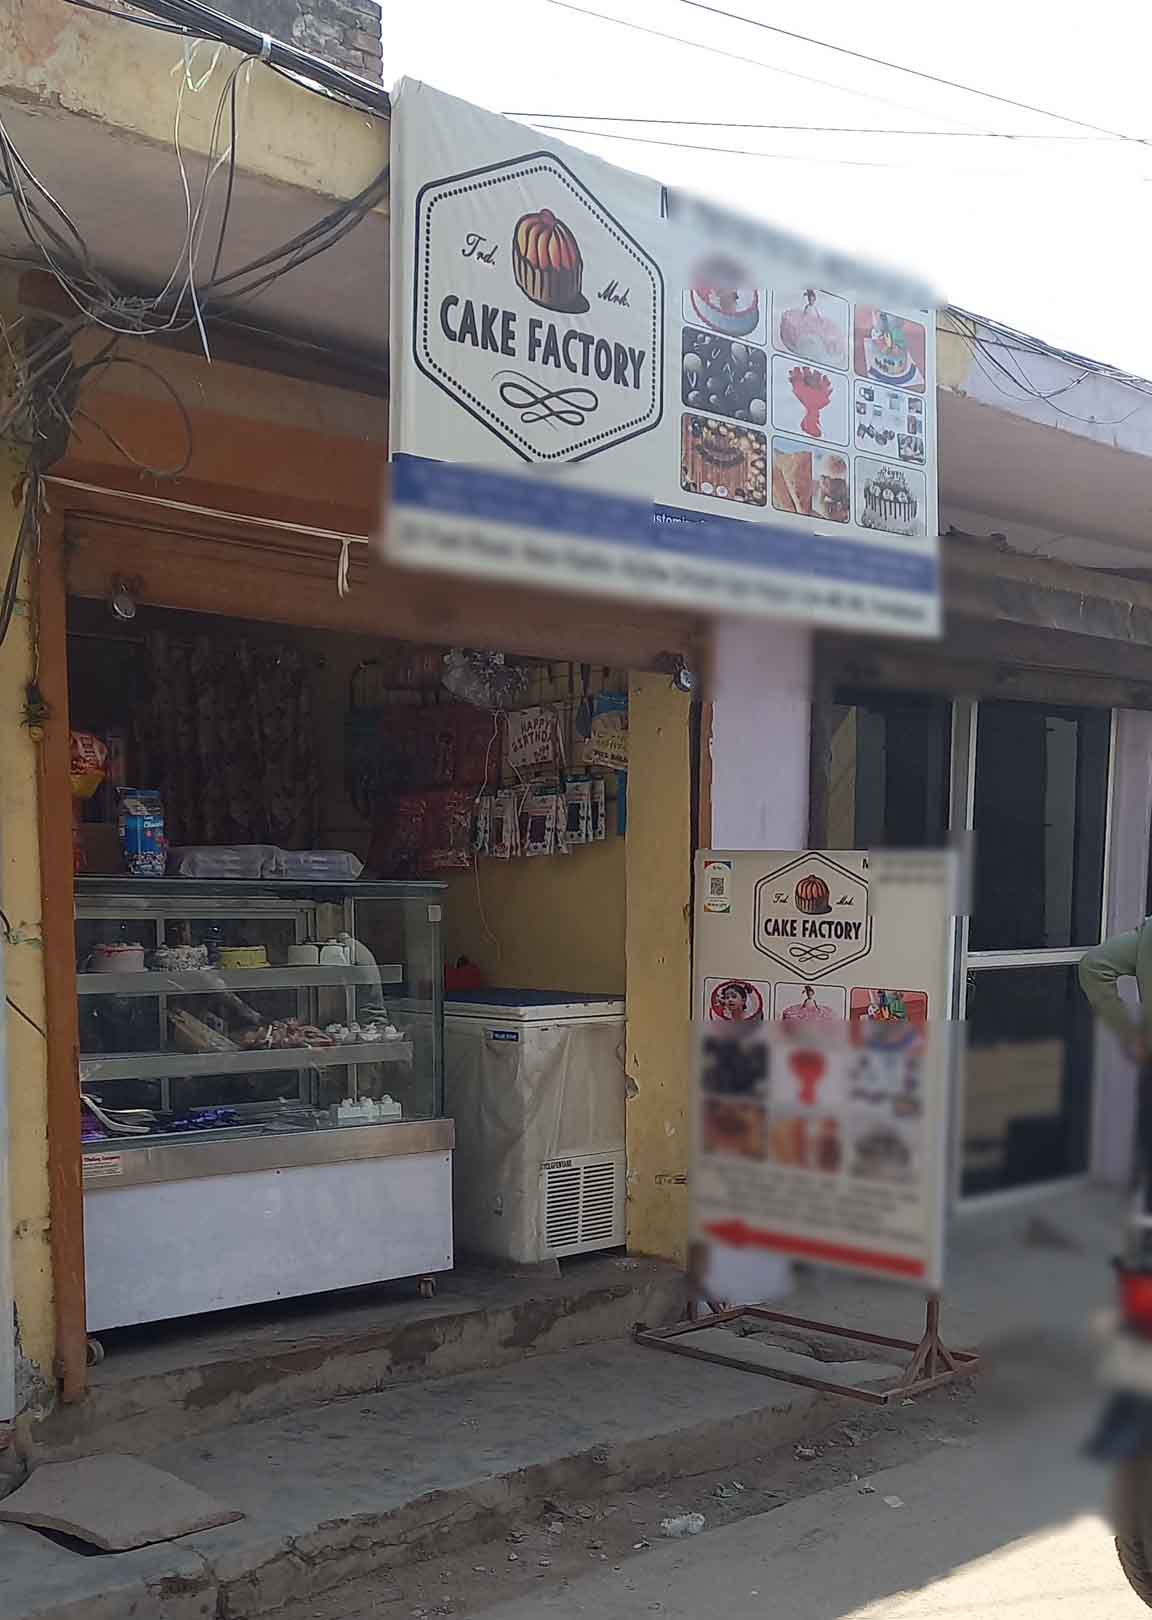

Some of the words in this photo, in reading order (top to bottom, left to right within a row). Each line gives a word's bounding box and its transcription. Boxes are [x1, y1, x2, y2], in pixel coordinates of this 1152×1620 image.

[439, 294, 516, 357] CAKE
[528, 318, 645, 389] FACTORY
[764, 918, 797, 937] CAKE
[802, 919, 862, 940] FACTORY
